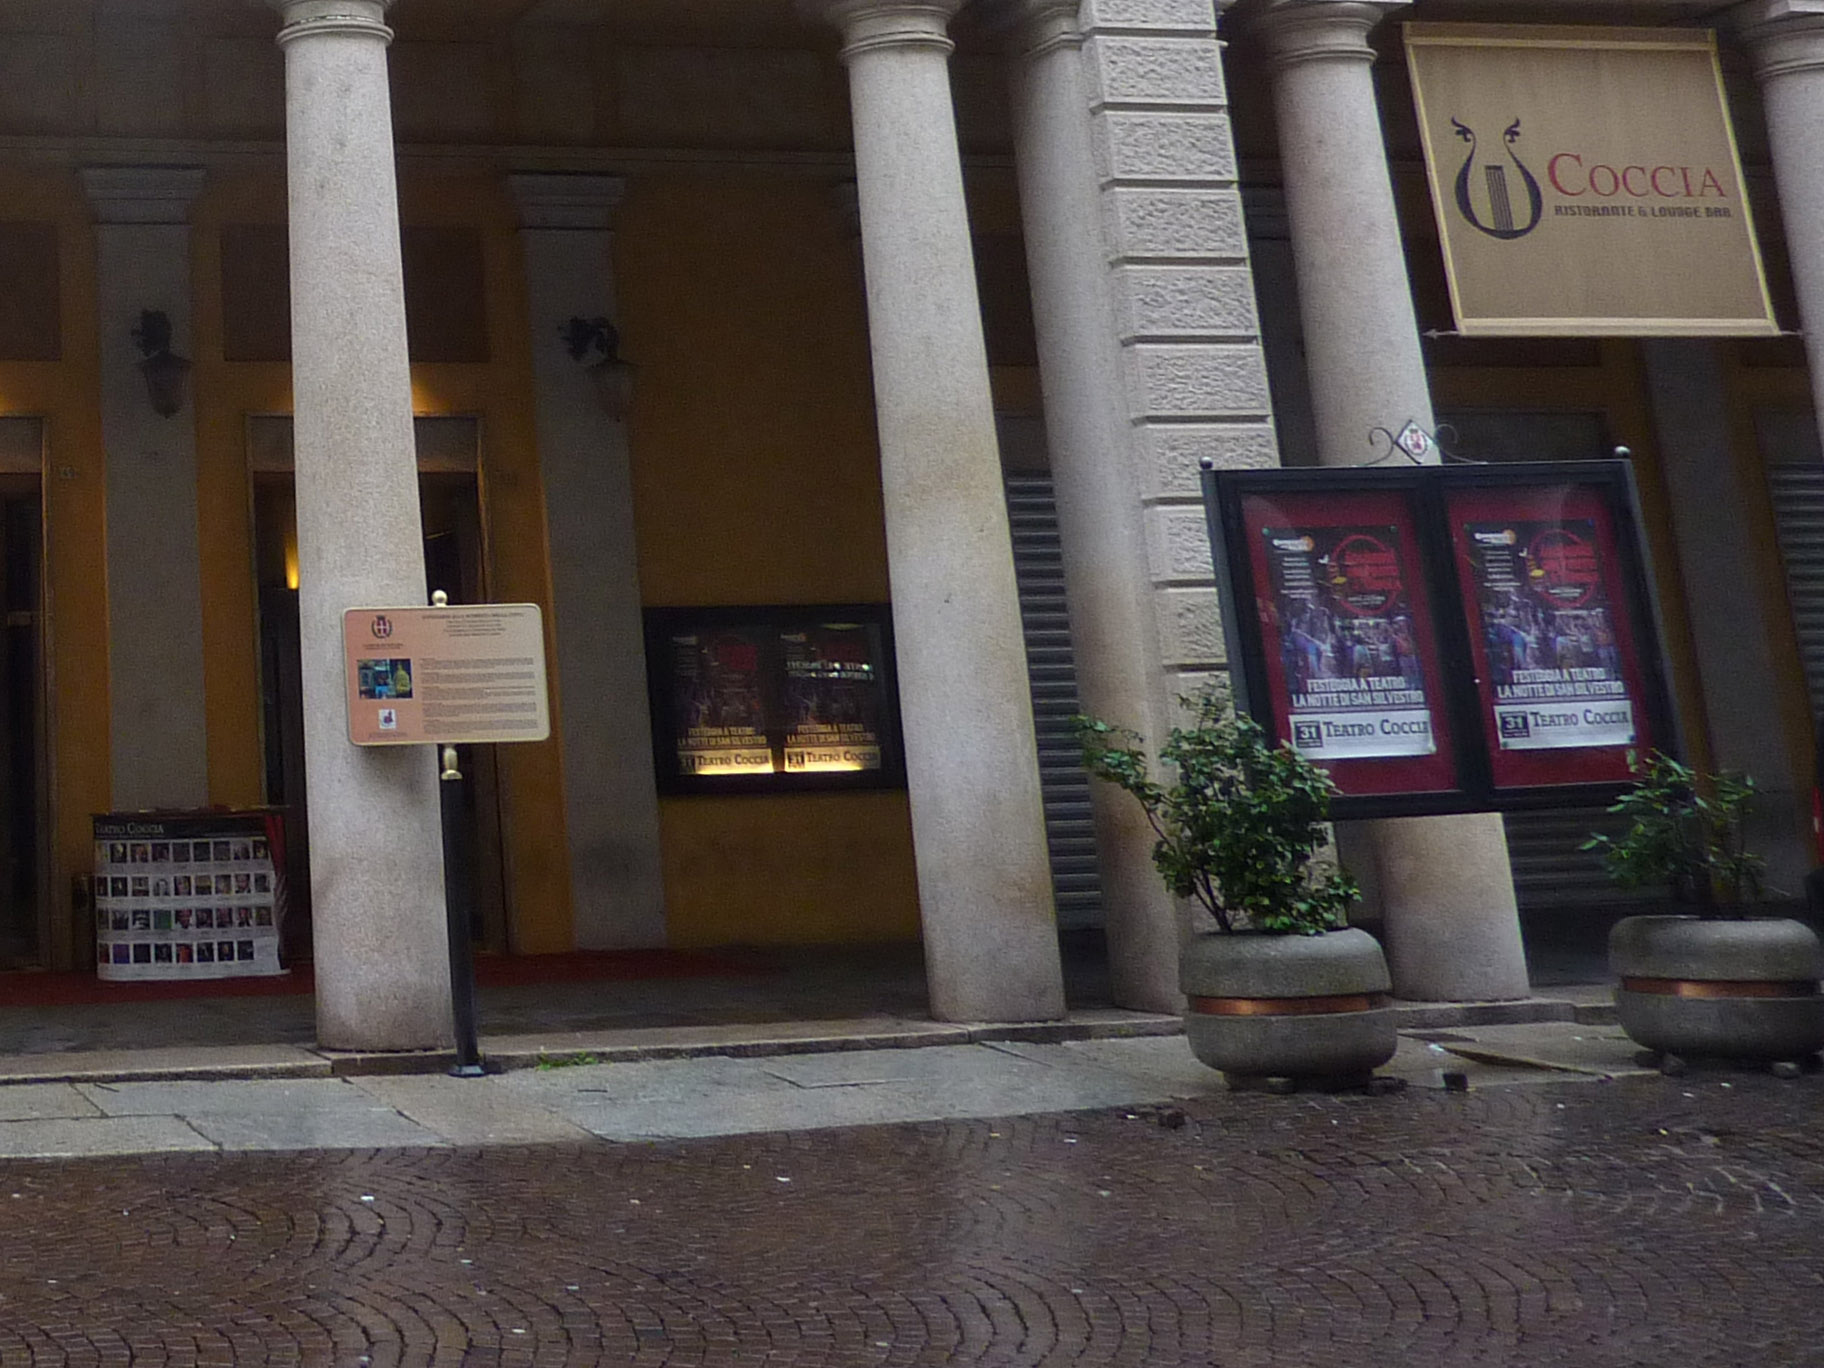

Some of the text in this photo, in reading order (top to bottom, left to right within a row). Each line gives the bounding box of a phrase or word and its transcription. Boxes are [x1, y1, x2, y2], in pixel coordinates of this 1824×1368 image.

[1547, 152, 1728, 198] COCCIA
[1554, 204, 1732, 219] RISTORANTE & LOUNGE BAR
[1530, 709, 1629, 727] TEATRO COCCIA
[1323, 721, 1374, 737] TEATRO
